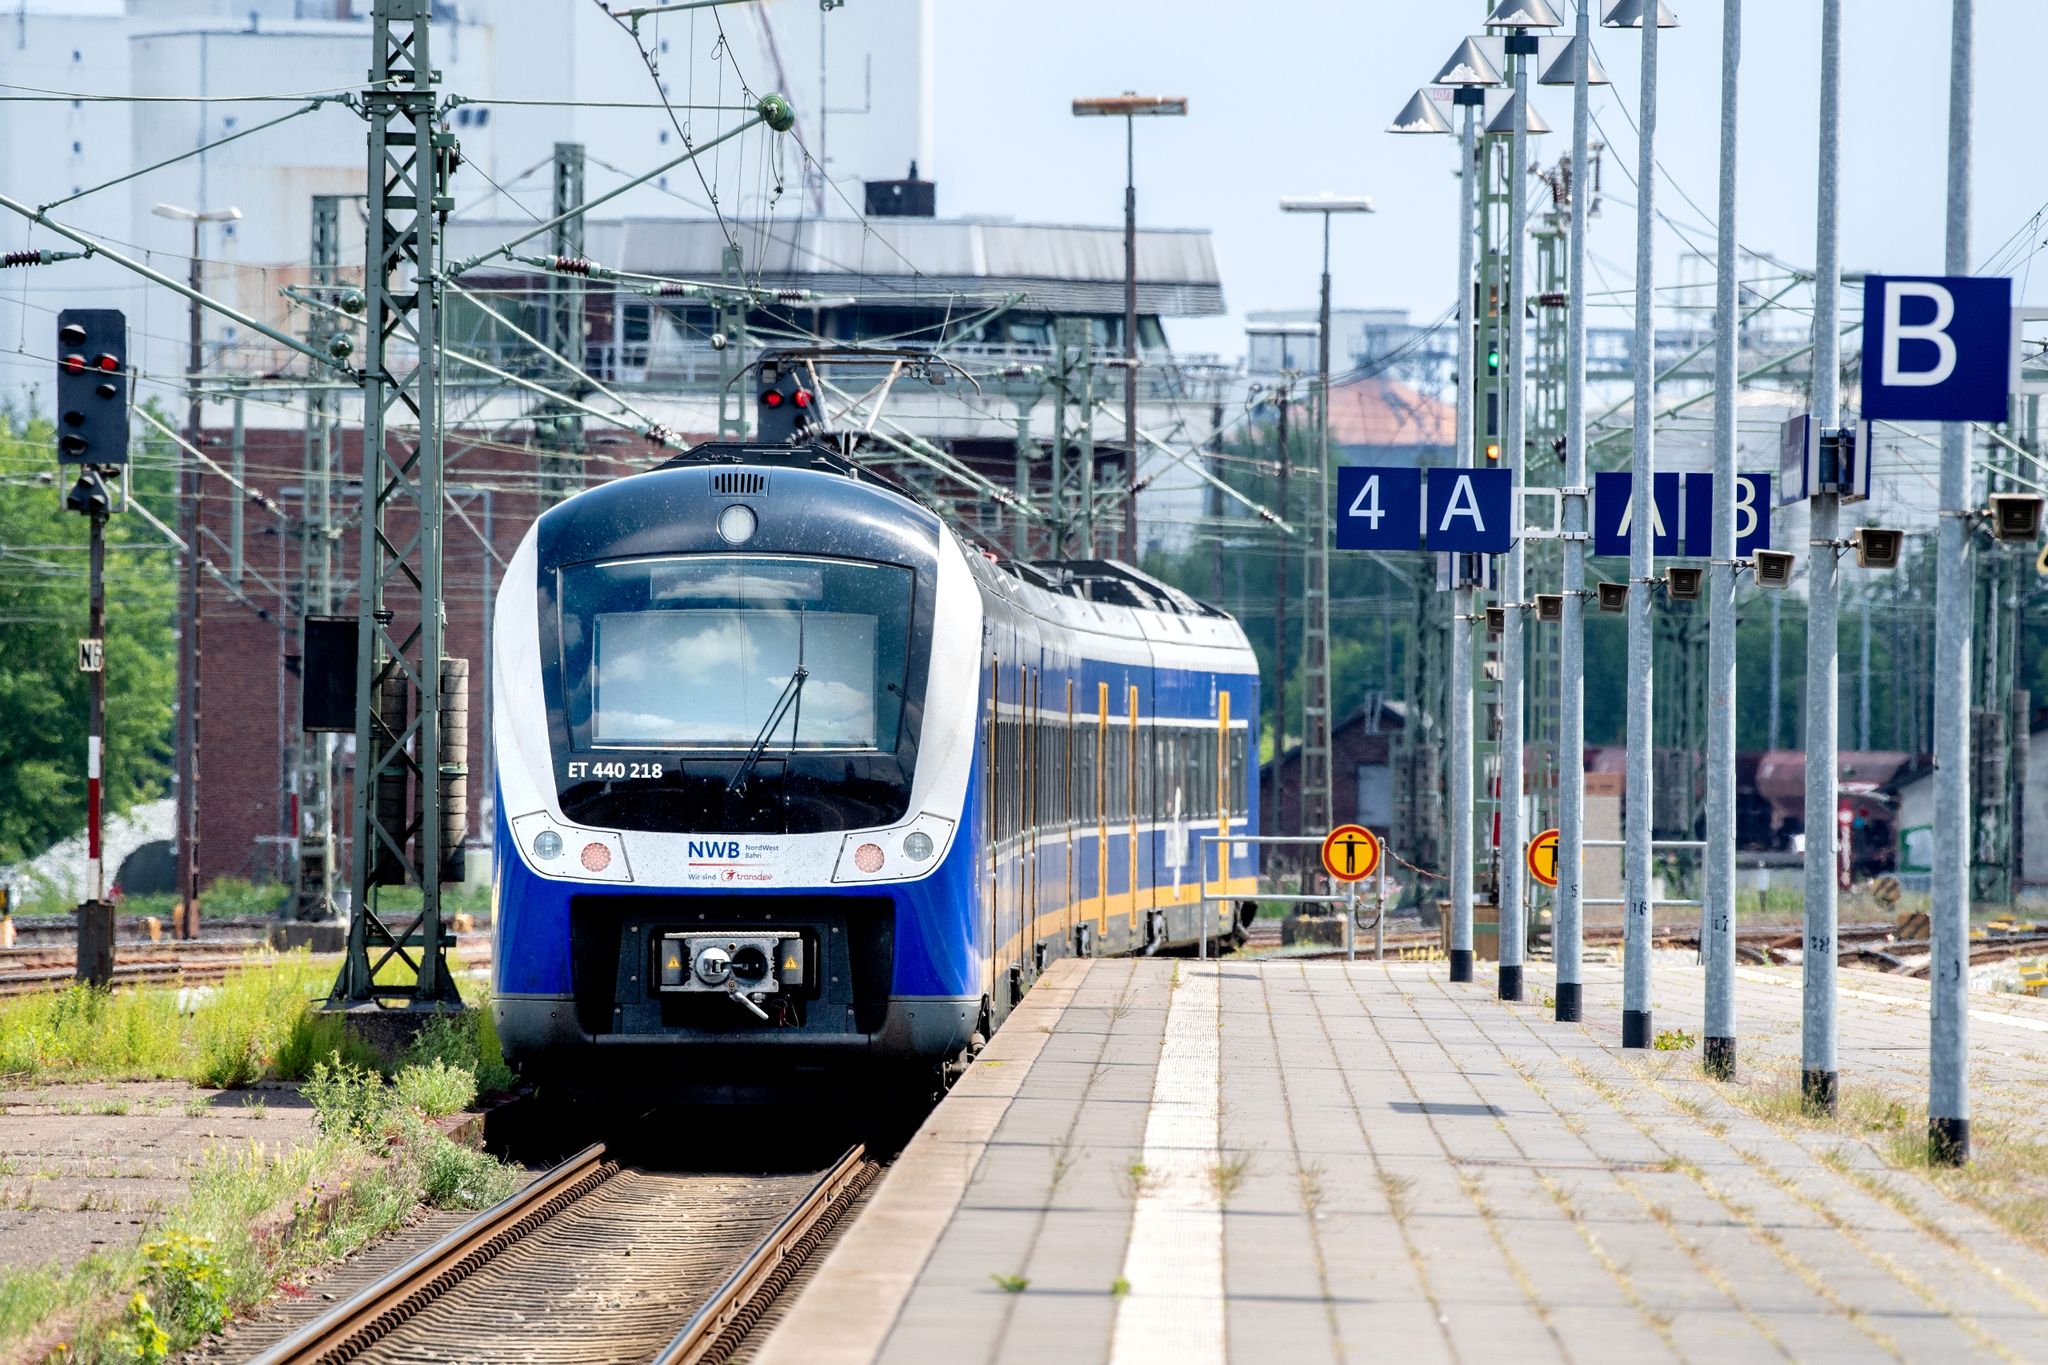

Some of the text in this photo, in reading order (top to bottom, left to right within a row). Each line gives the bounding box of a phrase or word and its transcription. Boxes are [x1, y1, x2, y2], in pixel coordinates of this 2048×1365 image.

[1881, 281, 1957, 387] B
[1348, 474, 1486, 532] 4 A
[568, 762, 663, 779] ET 440 218
[688, 841, 740, 859] NWB
[745, 844, 779, 852] NordWest
[736, 870, 773, 881] transdev
